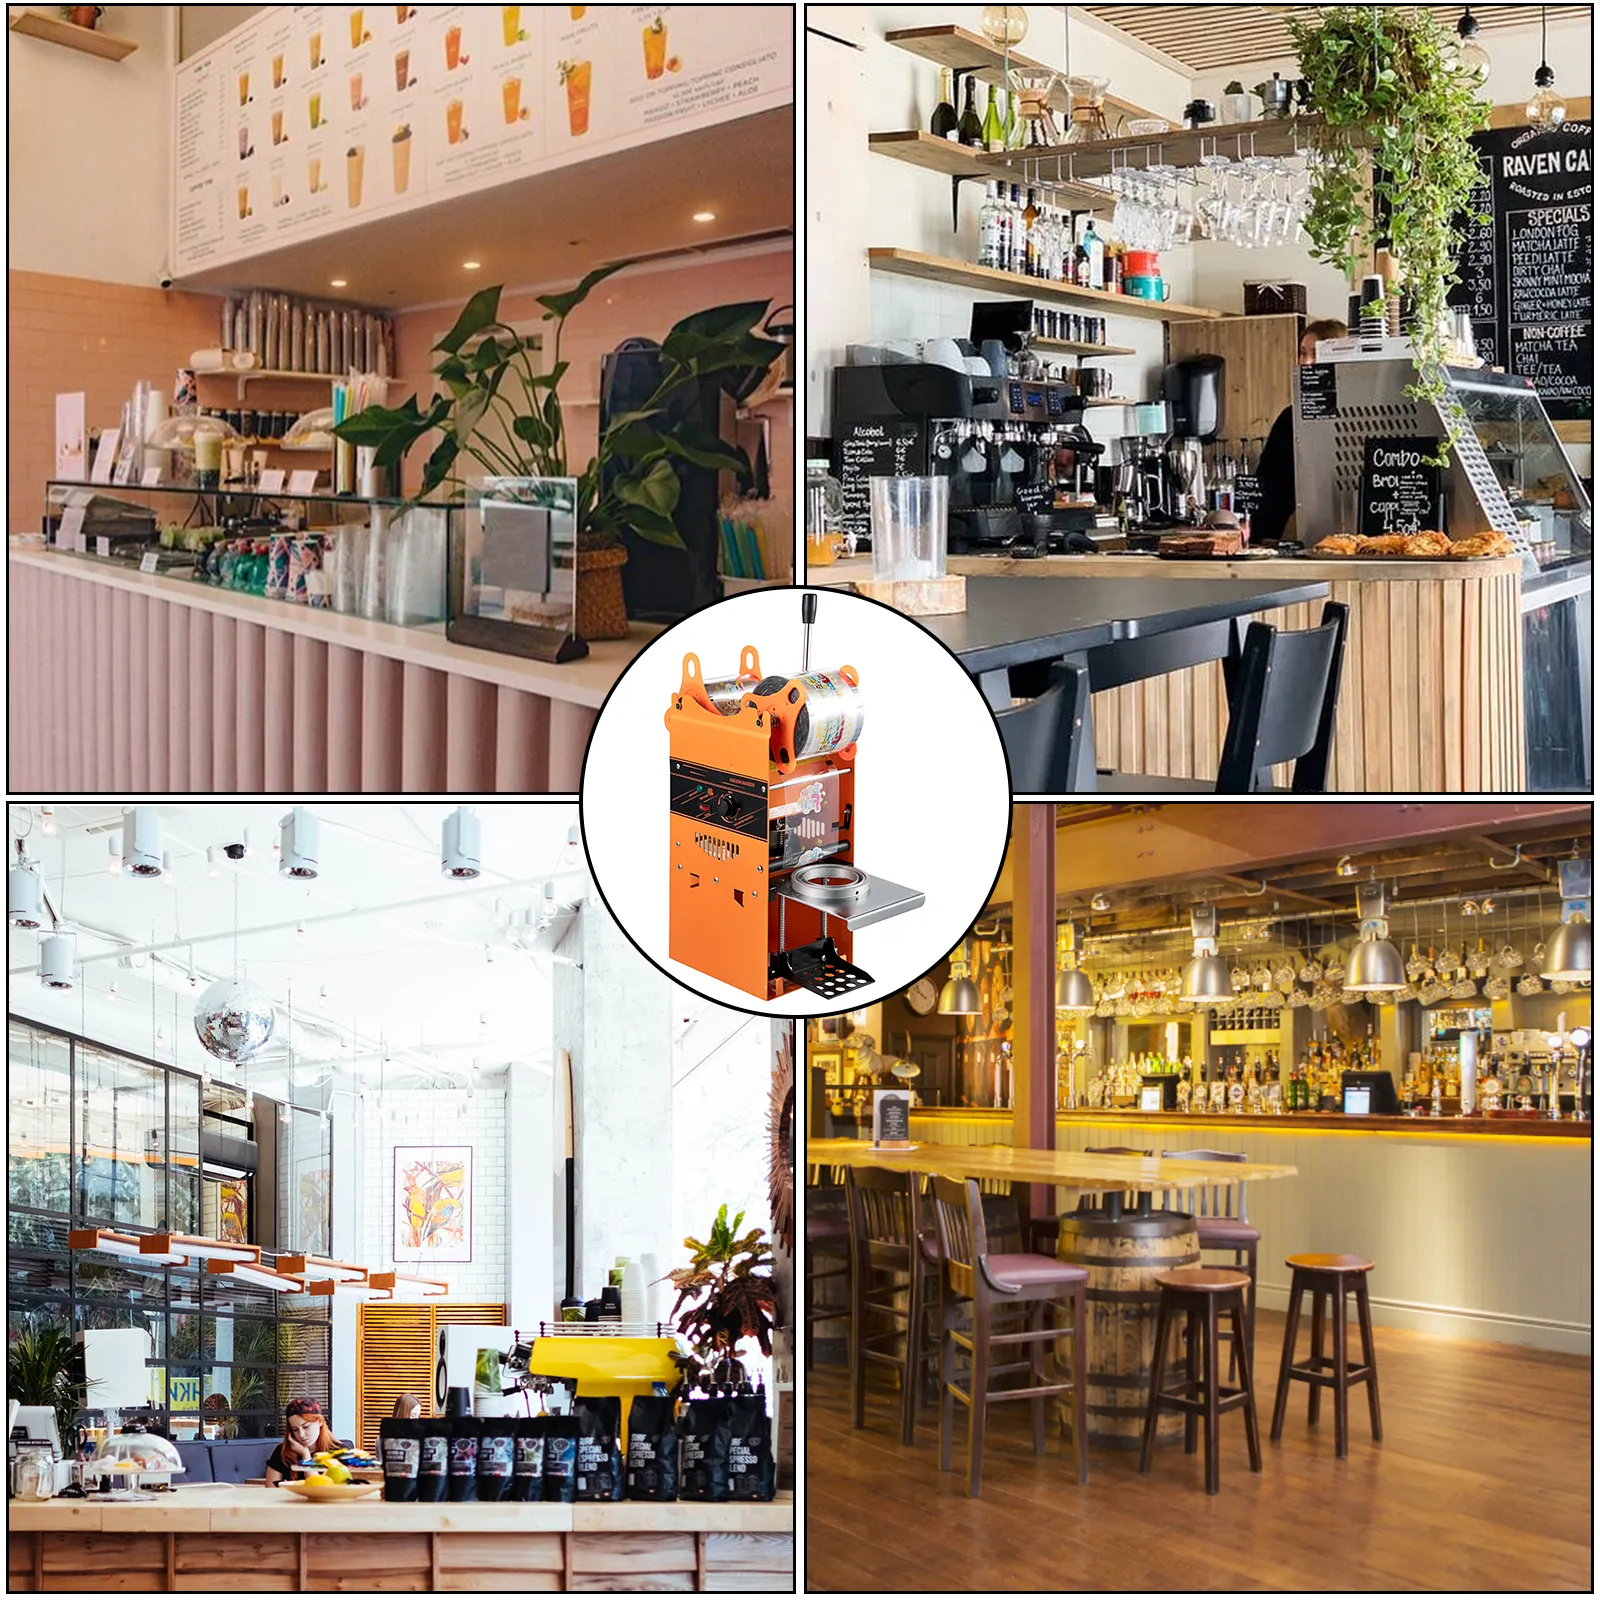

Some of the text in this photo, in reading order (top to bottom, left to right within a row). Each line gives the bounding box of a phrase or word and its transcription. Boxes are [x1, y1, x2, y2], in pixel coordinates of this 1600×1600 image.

[1503, 148, 1592, 178] RAVEN CA
[1509, 181, 1549, 201] ROASTED
[1553, 192, 1564, 201] IN
[1528, 205, 1591, 227] SPECIALS
[1511, 224, 1579, 240] LONDON FOG
[1512, 237, 1580, 252] MATCHA LATTE
[1543, 250, 1576, 264] LATTE
[1513, 263, 1565, 276] DIRTY CHAI
[1475, 292, 1484, 303] 6
[1523, 324, 1586, 340] NON-COFFEE
[1515, 339, 1578, 353] MATCHA TEA
[1515, 353, 1539, 364] CHAI
[1373, 448, 1420, 468] Combo
[729, 1446, 750, 1455] PECIAL
[729, 1455, 758, 1464] SPRESSO
[729, 1463, 747, 1473] LEND
